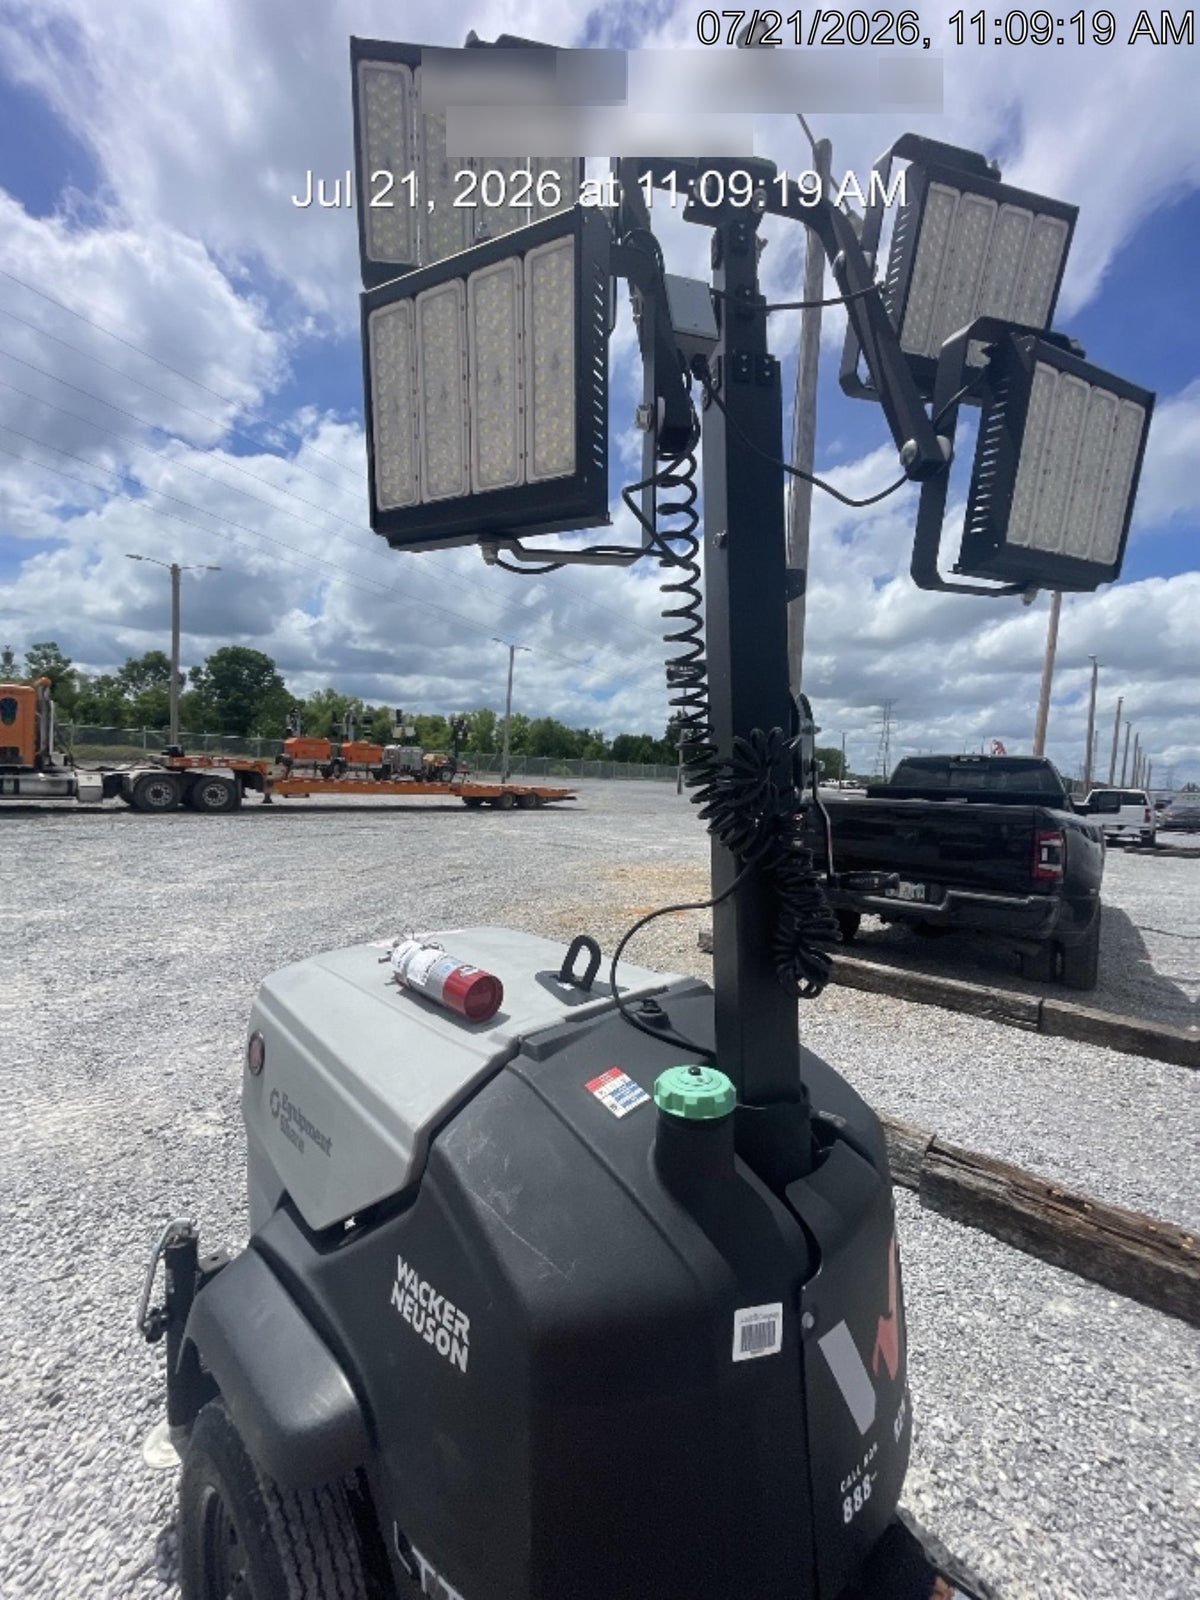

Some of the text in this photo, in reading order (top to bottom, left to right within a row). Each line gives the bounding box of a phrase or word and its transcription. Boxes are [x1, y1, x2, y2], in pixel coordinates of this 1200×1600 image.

[390, 1280, 470, 1374] NEUSON
[397, 1254, 470, 1346] WACKER
[840, 1464, 862, 1494] CALL
